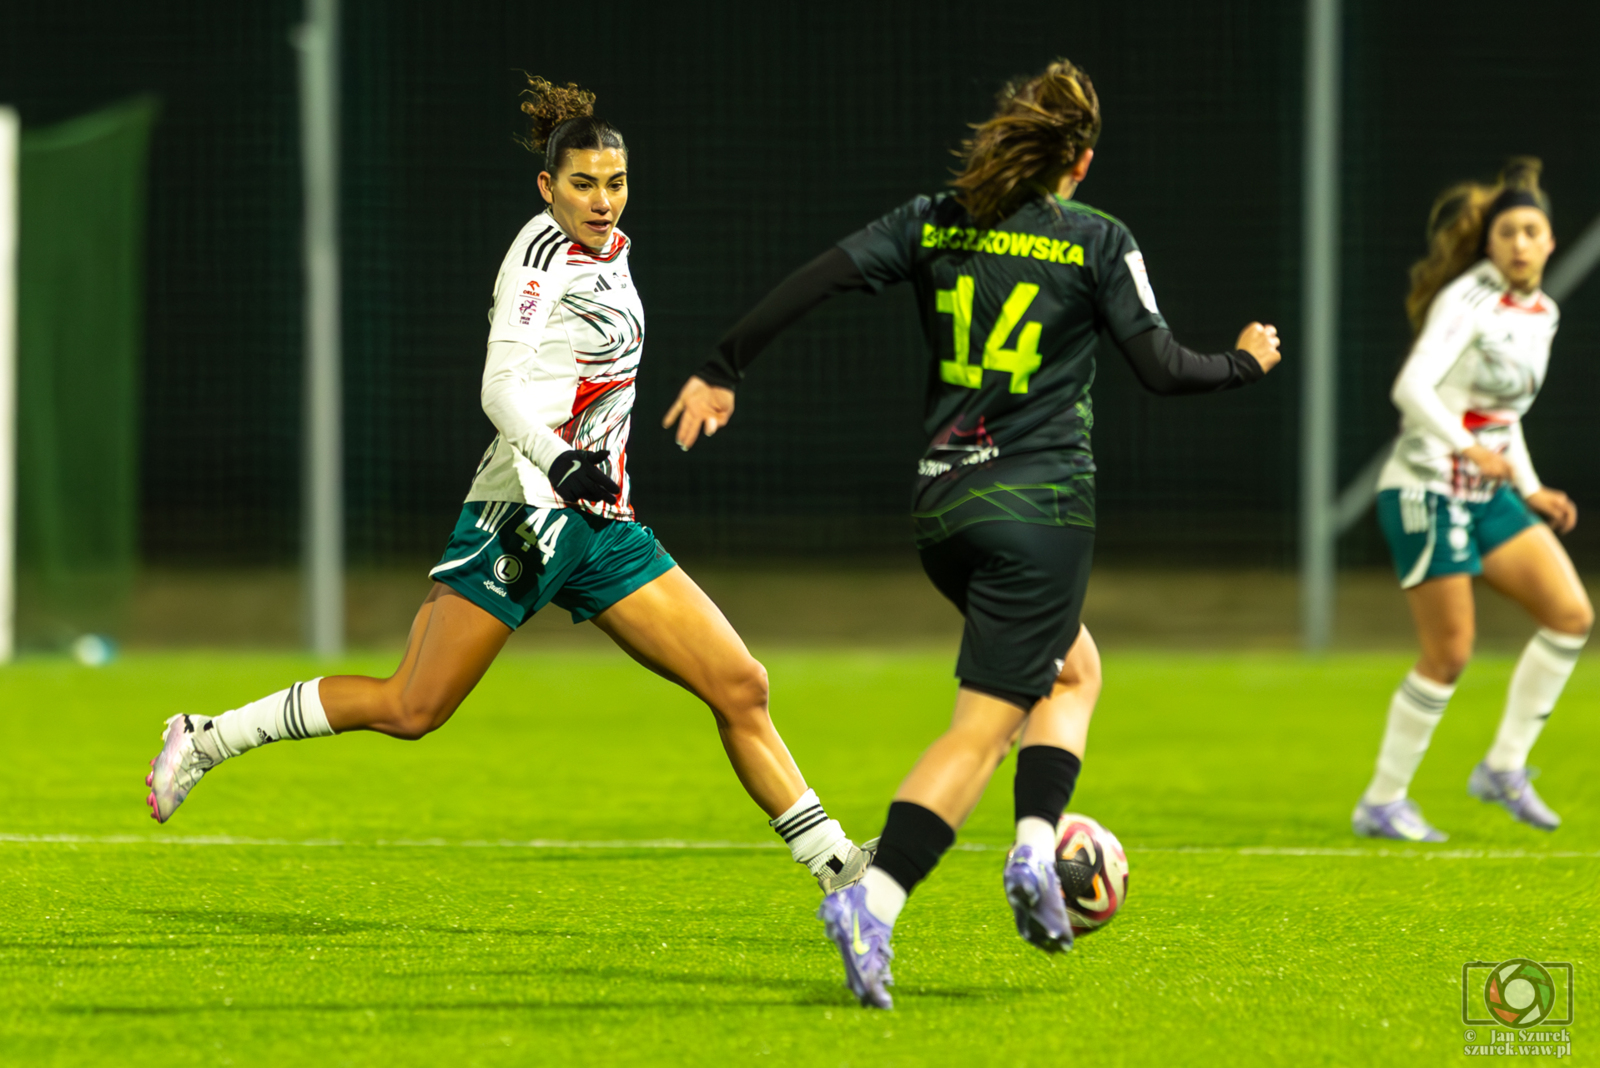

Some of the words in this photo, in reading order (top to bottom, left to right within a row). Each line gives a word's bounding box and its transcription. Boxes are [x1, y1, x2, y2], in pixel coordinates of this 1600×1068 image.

[936, 274, 1043, 394] 14
[515, 508, 568, 566] 44
[483, 580, 507, 597] Ladies
